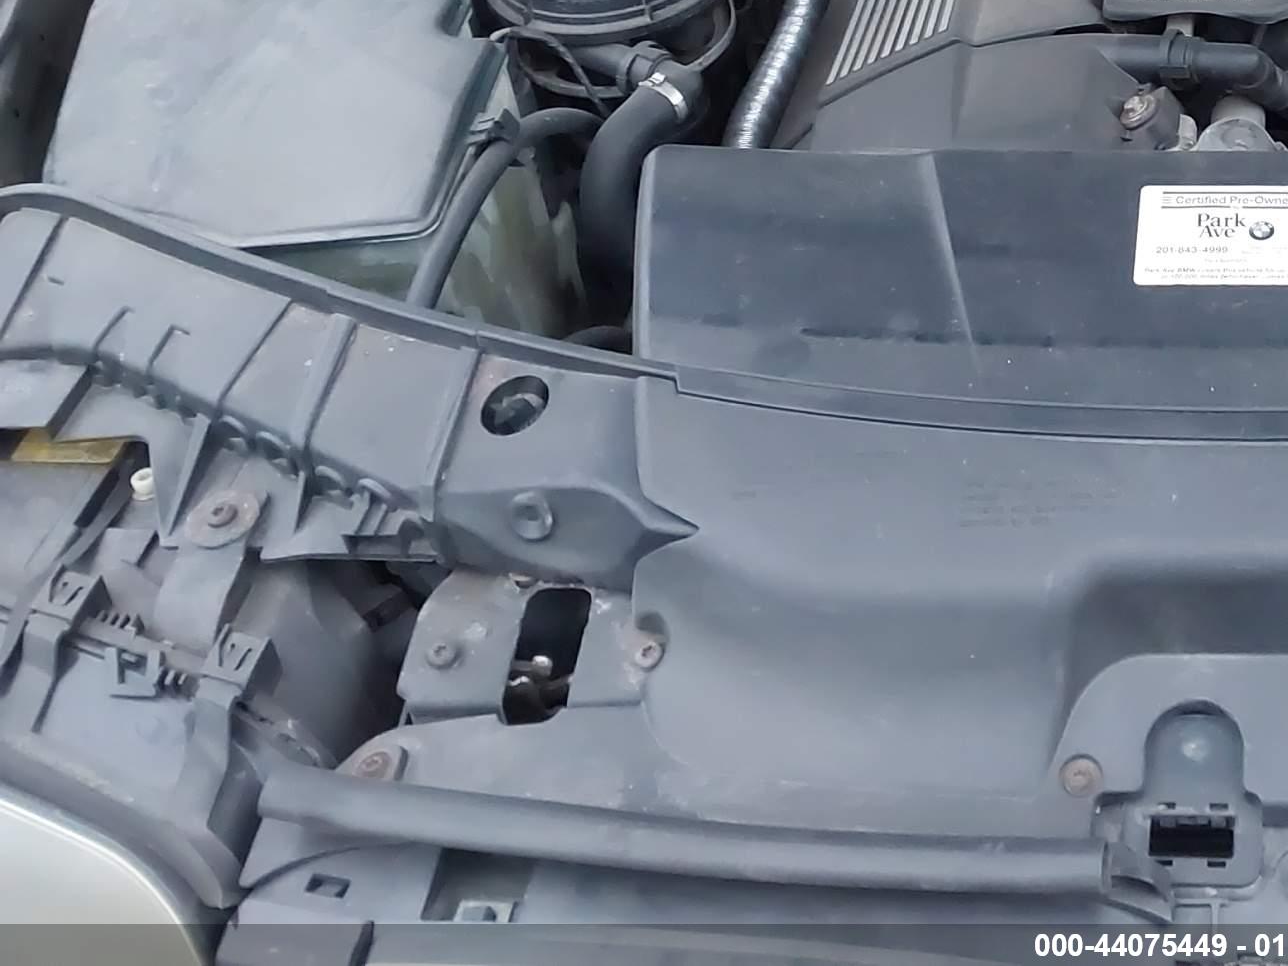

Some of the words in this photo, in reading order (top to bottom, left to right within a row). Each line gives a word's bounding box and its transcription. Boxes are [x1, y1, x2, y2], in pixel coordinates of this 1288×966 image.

[1175, 195, 1227, 204] Certified
[1197, 212, 1247, 227] Park
[1199, 225, 1236, 238] Ave
